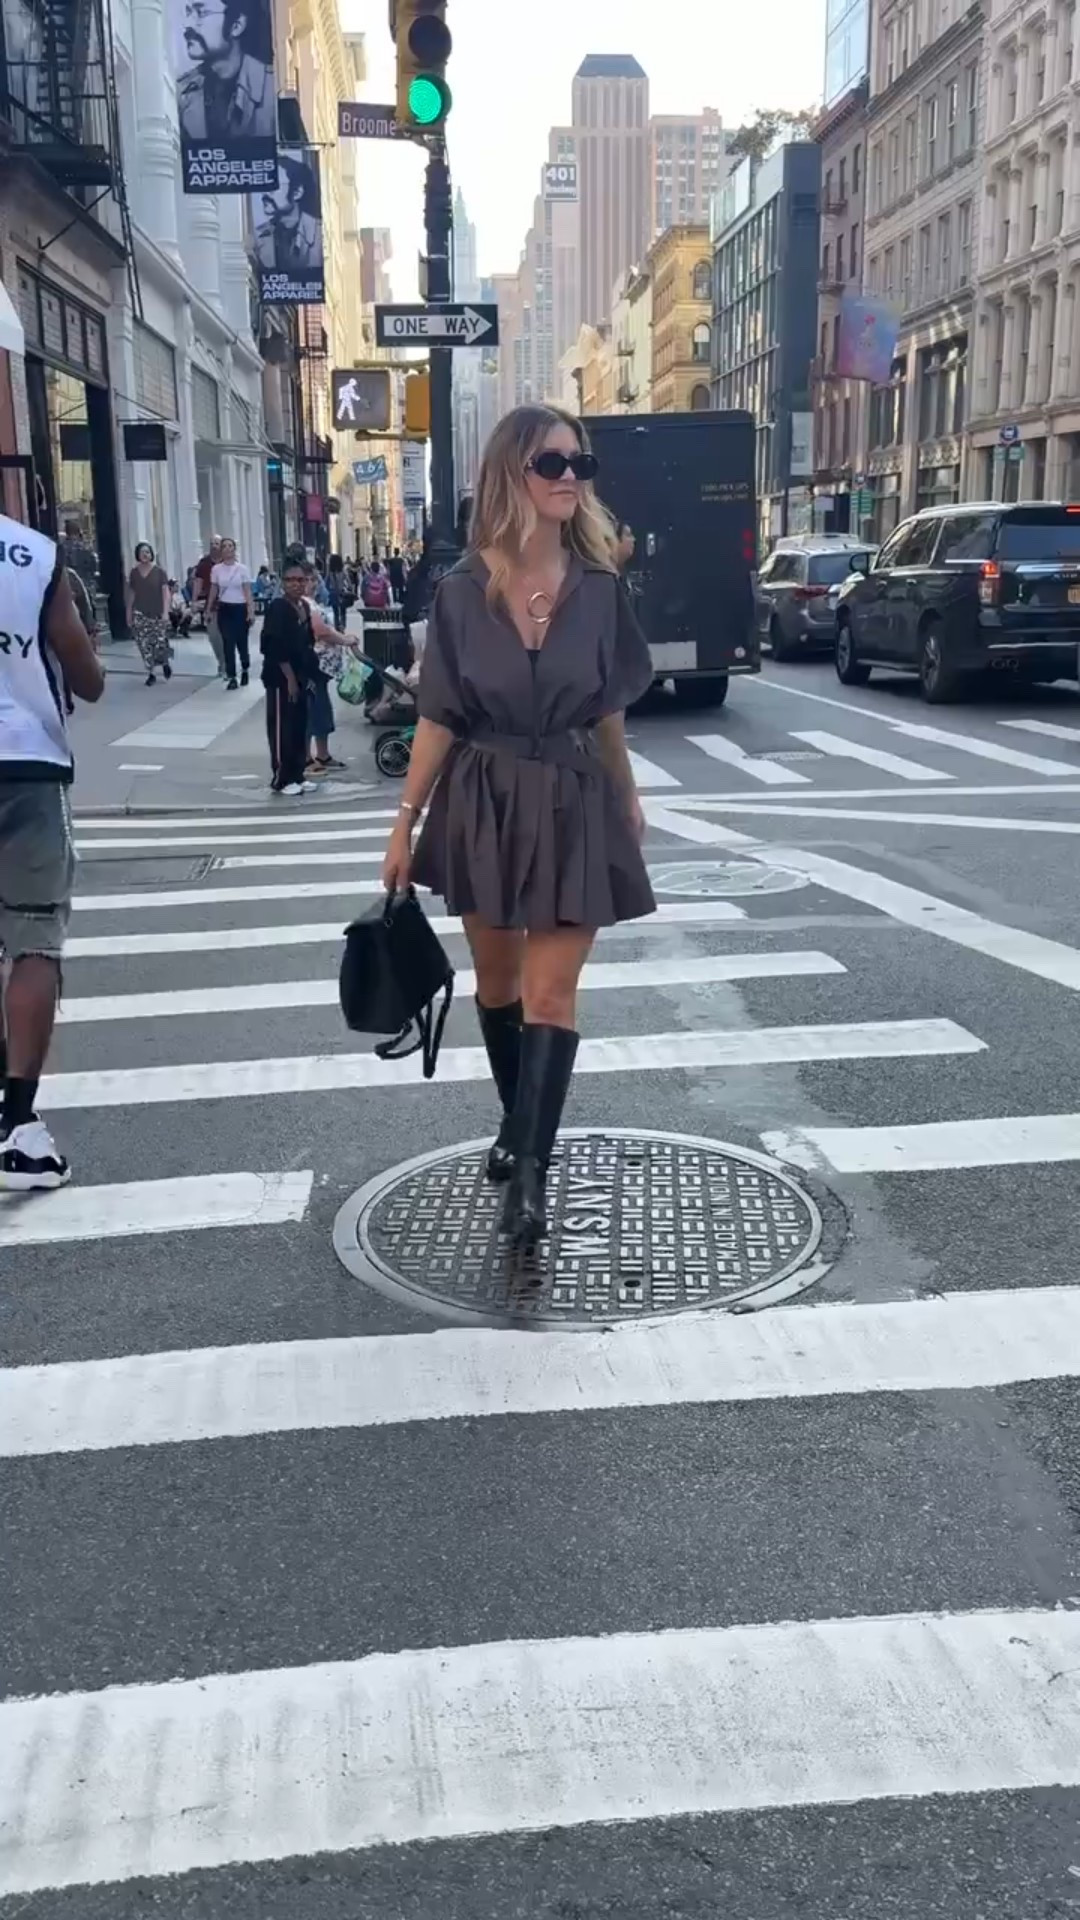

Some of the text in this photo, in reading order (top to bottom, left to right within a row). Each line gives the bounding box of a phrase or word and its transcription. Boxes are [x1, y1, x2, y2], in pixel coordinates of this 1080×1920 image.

[342, 112, 397, 136] Broome
[188, 148, 226, 161] LOS
[188, 159, 276, 174] ANGELES
[546, 162, 575, 181] 401
[189, 172, 275, 187] APPAREL
[262, 274, 289, 283] LOS
[262, 282, 322, 292] ANGELES
[263, 291, 322, 300] APPAREL
[393, 317, 481, 334] ONE WAY
[713, 1223, 739, 1260] MADE
